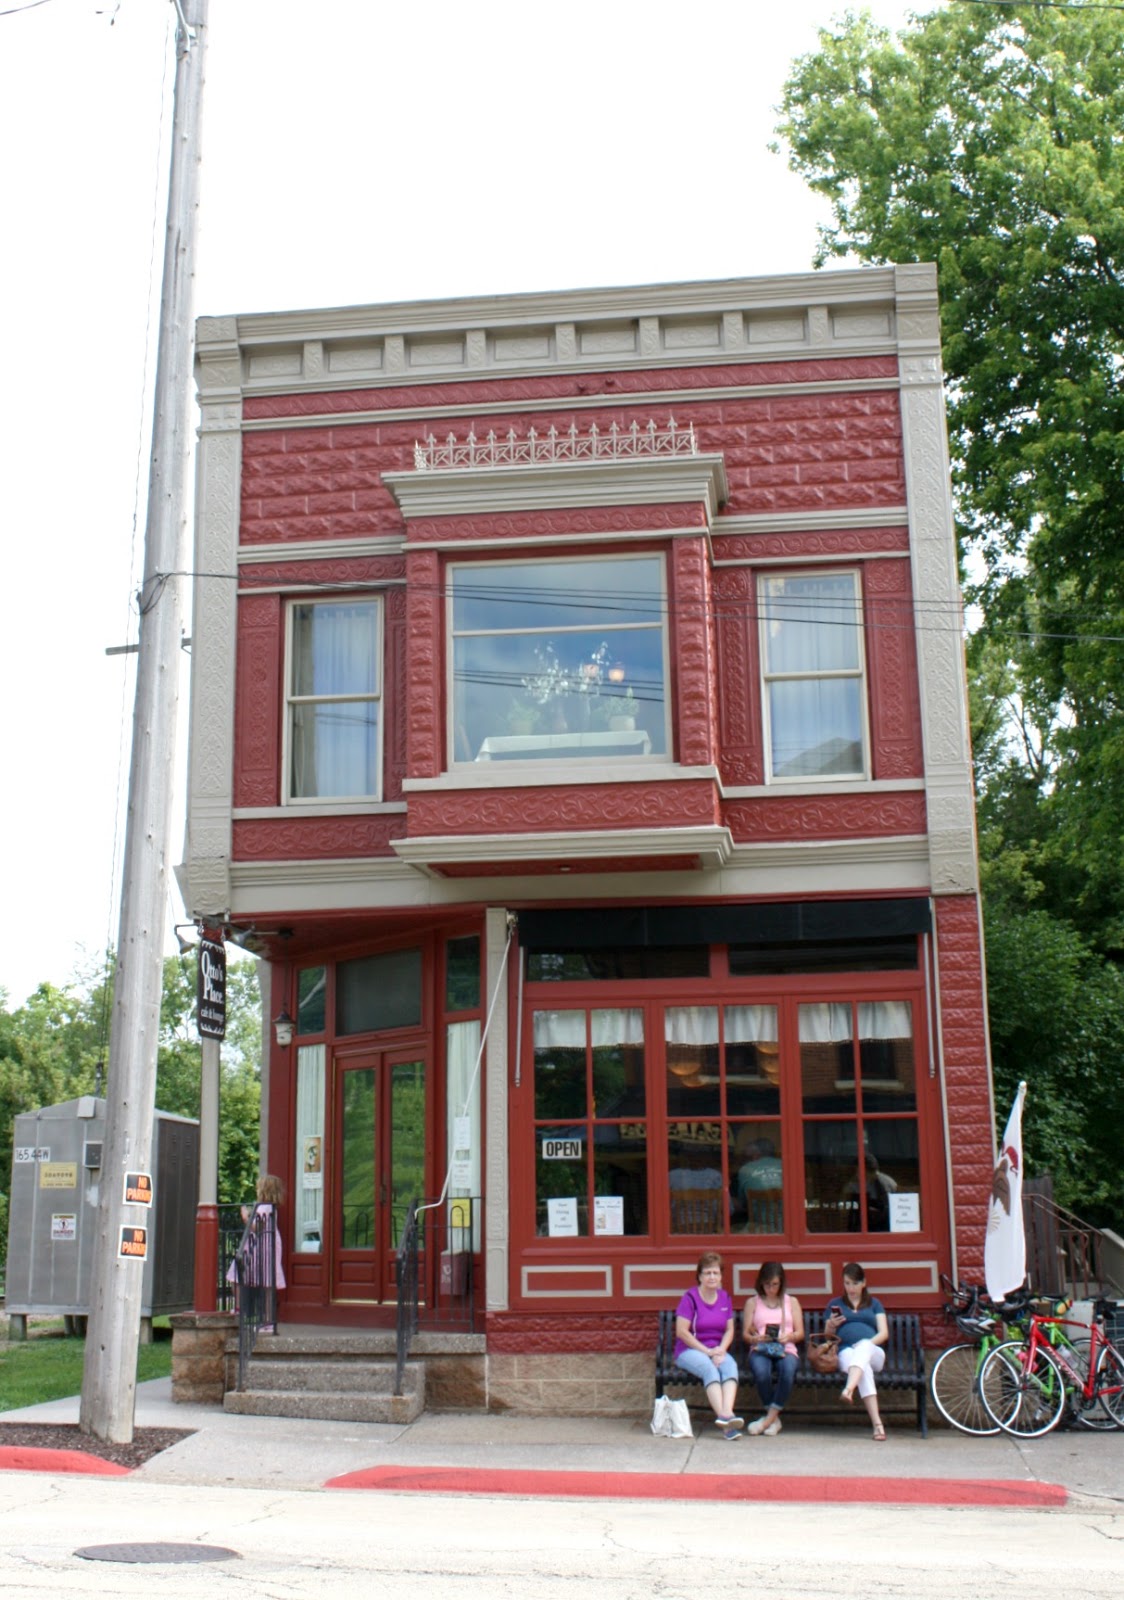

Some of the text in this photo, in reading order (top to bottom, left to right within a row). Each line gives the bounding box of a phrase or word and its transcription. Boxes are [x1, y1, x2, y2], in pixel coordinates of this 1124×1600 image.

[202, 951, 223, 981] Otto's
[203, 974, 223, 1004] Place
[546, 1141, 579, 1157] OPEN
[138, 1175, 148, 1189] NO
[134, 1229, 144, 1242] NO
